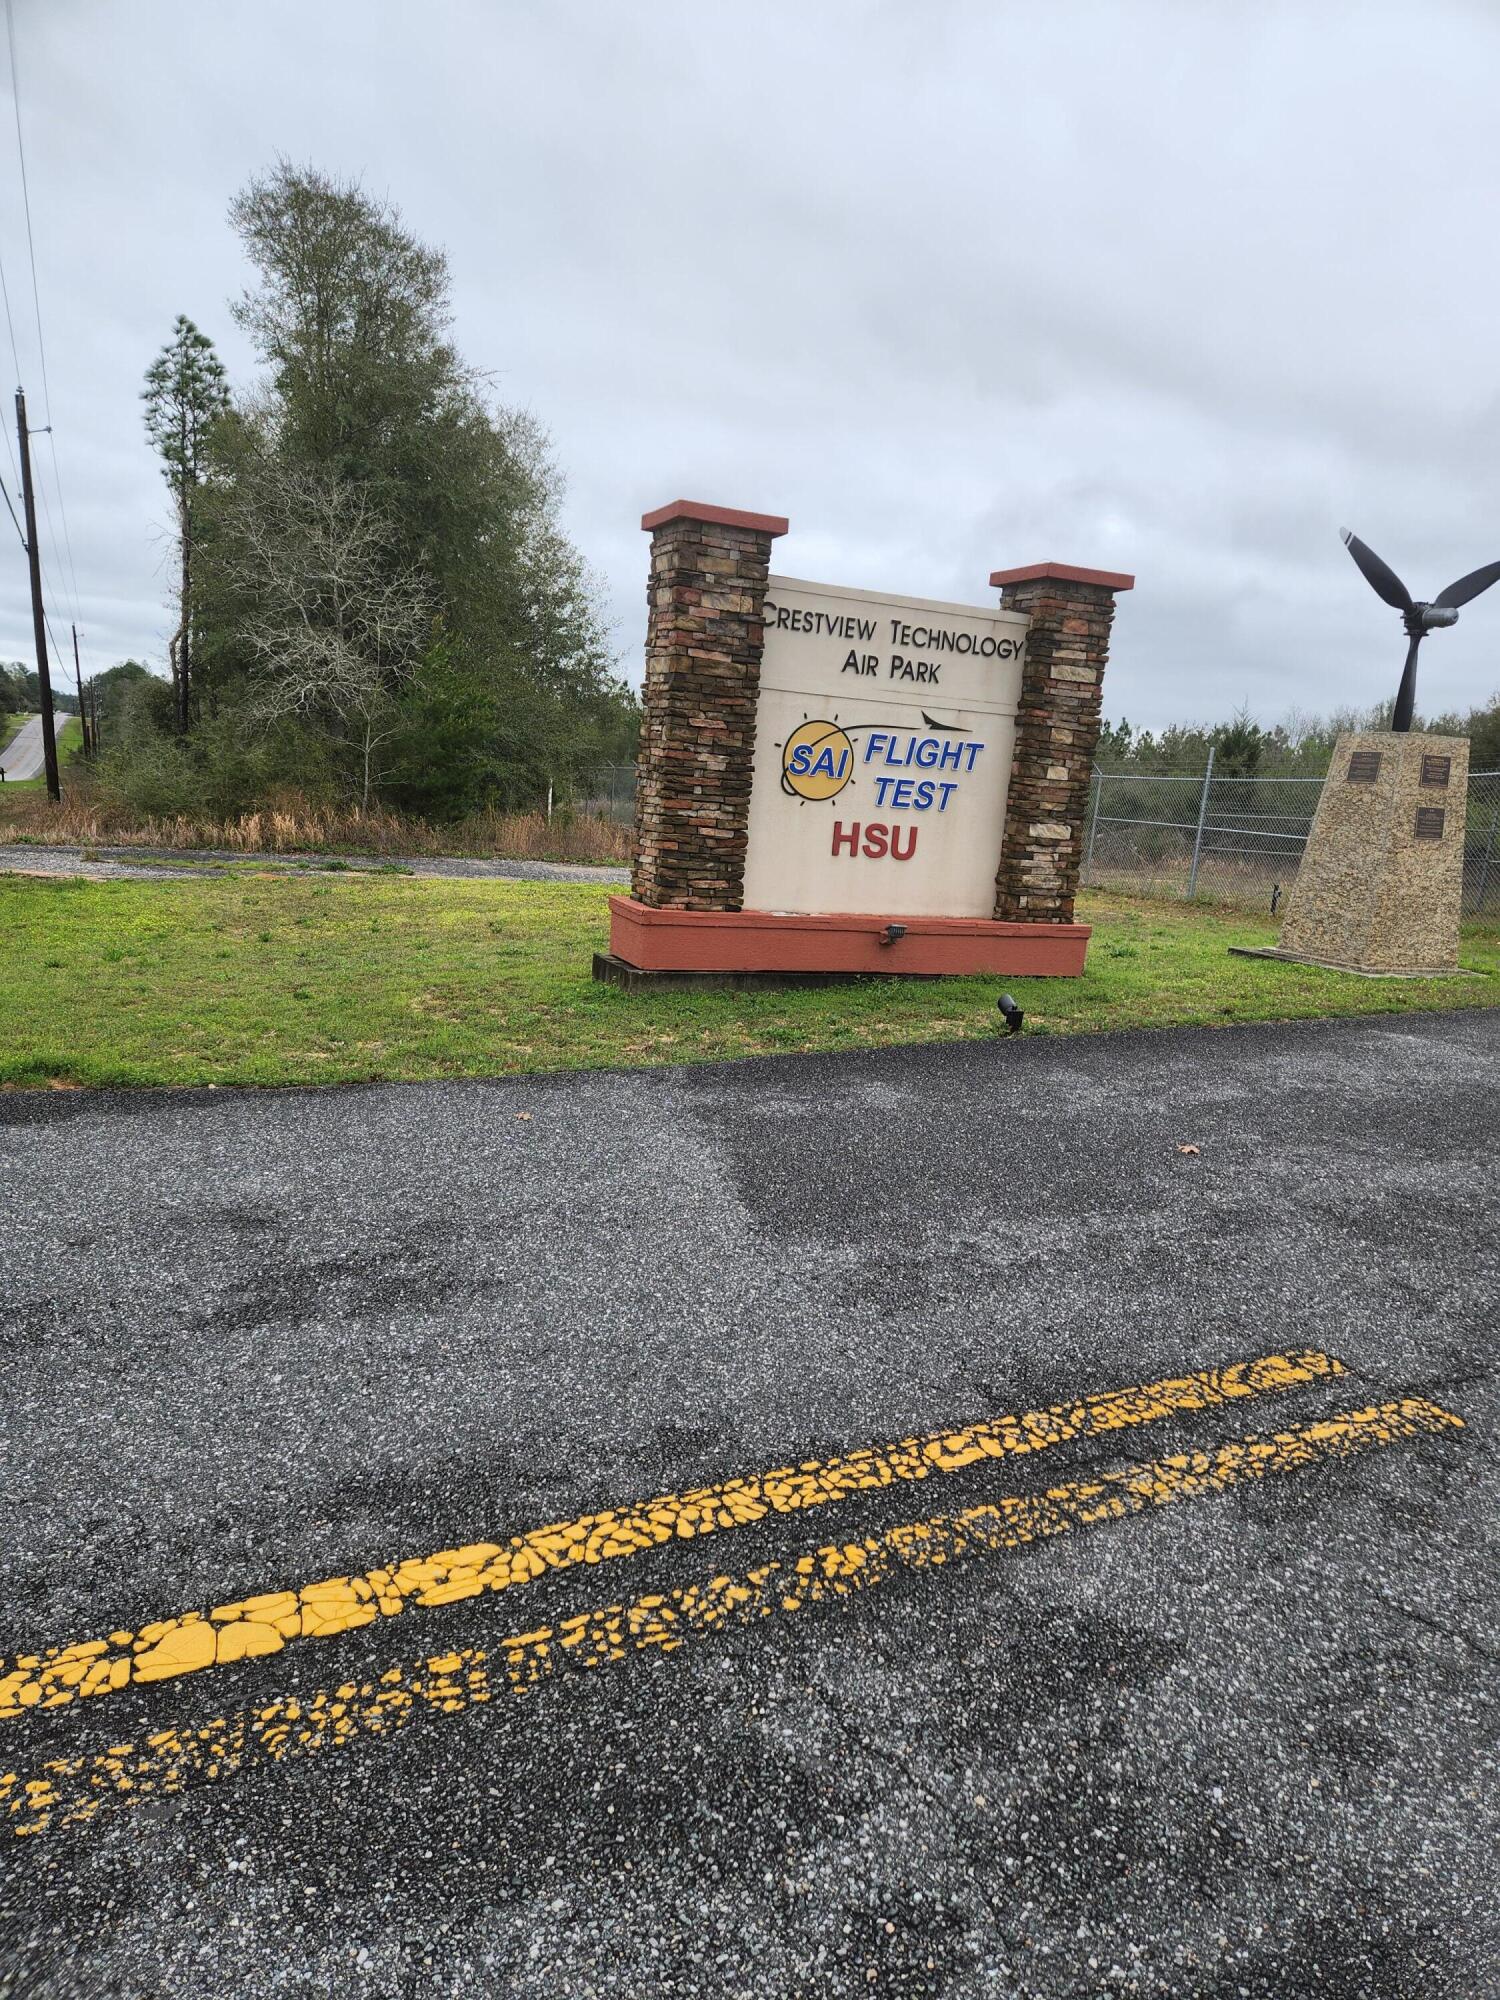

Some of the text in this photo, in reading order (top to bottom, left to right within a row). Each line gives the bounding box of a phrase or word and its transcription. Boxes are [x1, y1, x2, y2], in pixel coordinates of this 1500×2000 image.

[890, 619, 1024, 661] TECHNOLOGY
[841, 649, 942, 684] AIR PARK
[789, 744, 849, 778] SAI
[864, 733, 985, 772] FLIGHT
[875, 776, 958, 812] TEST
[831, 821, 918, 860] HSU
